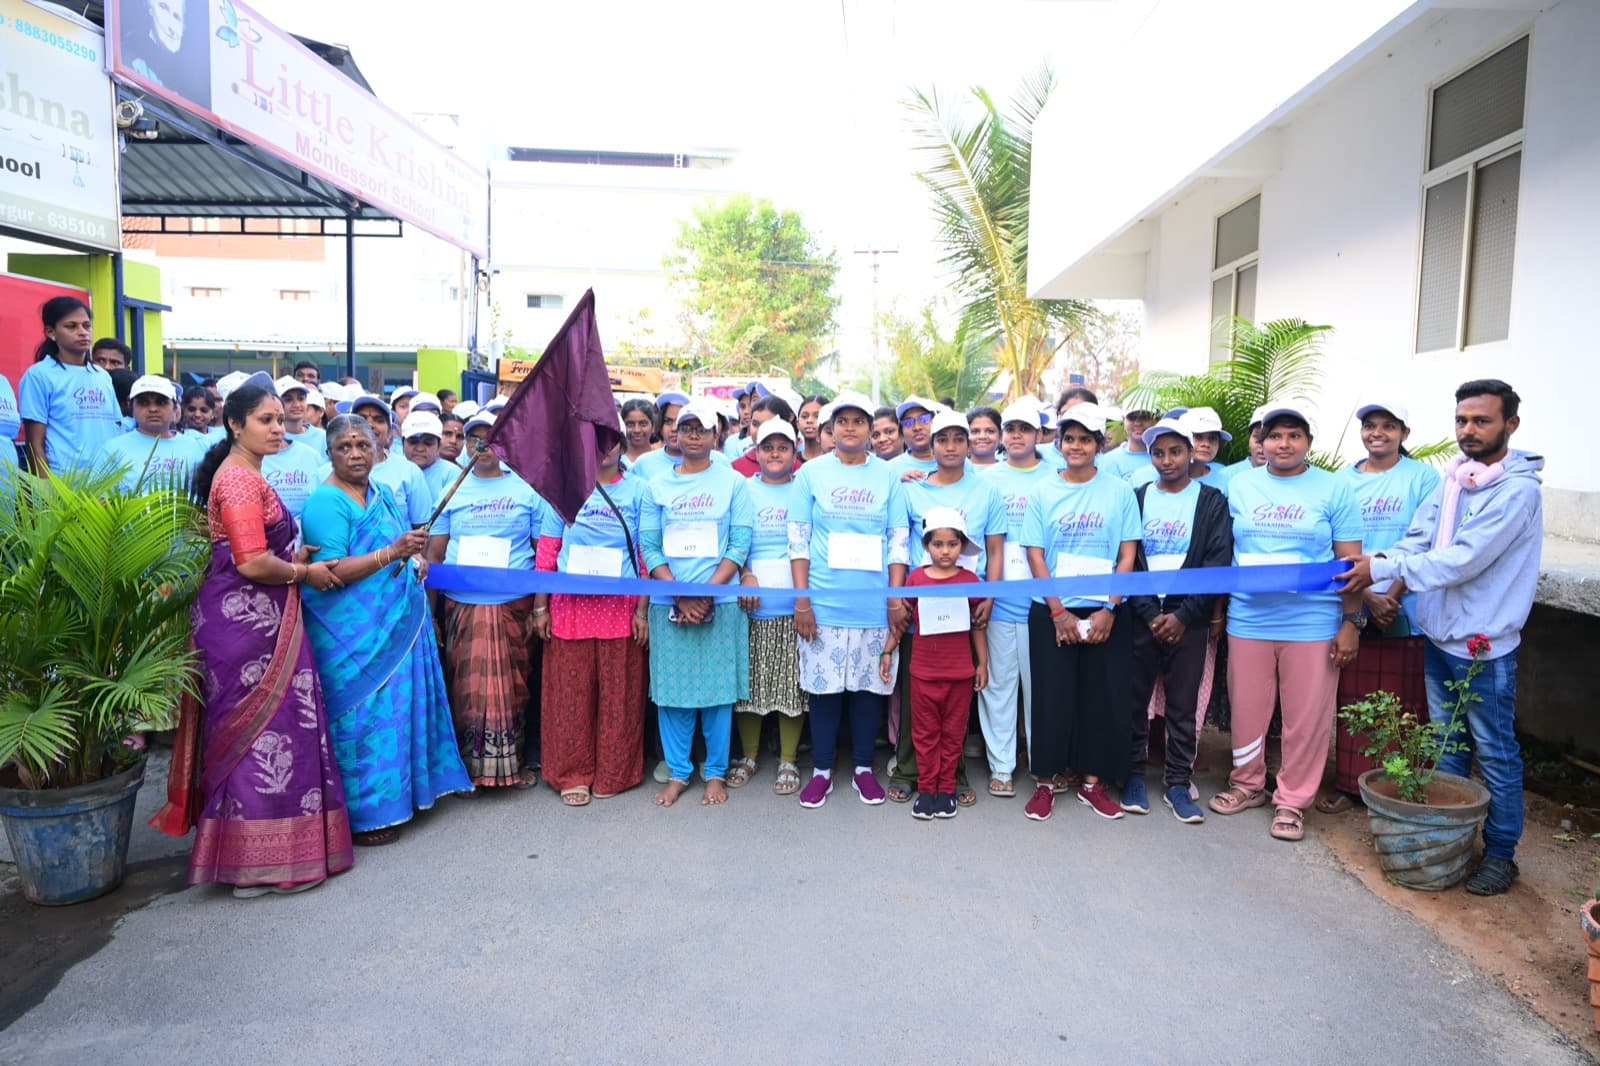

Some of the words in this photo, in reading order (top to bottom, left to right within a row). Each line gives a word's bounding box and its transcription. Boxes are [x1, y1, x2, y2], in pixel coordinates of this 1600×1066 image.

[15, 17, 97, 62] 8883055290
[239, 40, 355, 146] Little
[367, 121, 473, 216] Krishna
[295, 131, 387, 197] Montessori
[391, 184, 437, 221] School
[47, 211, 107, 240] 635104
[831, 486, 876, 504] Srishti
[1058, 511, 1105, 532] Srishti
[1252, 503, 1306, 521] Srishti
